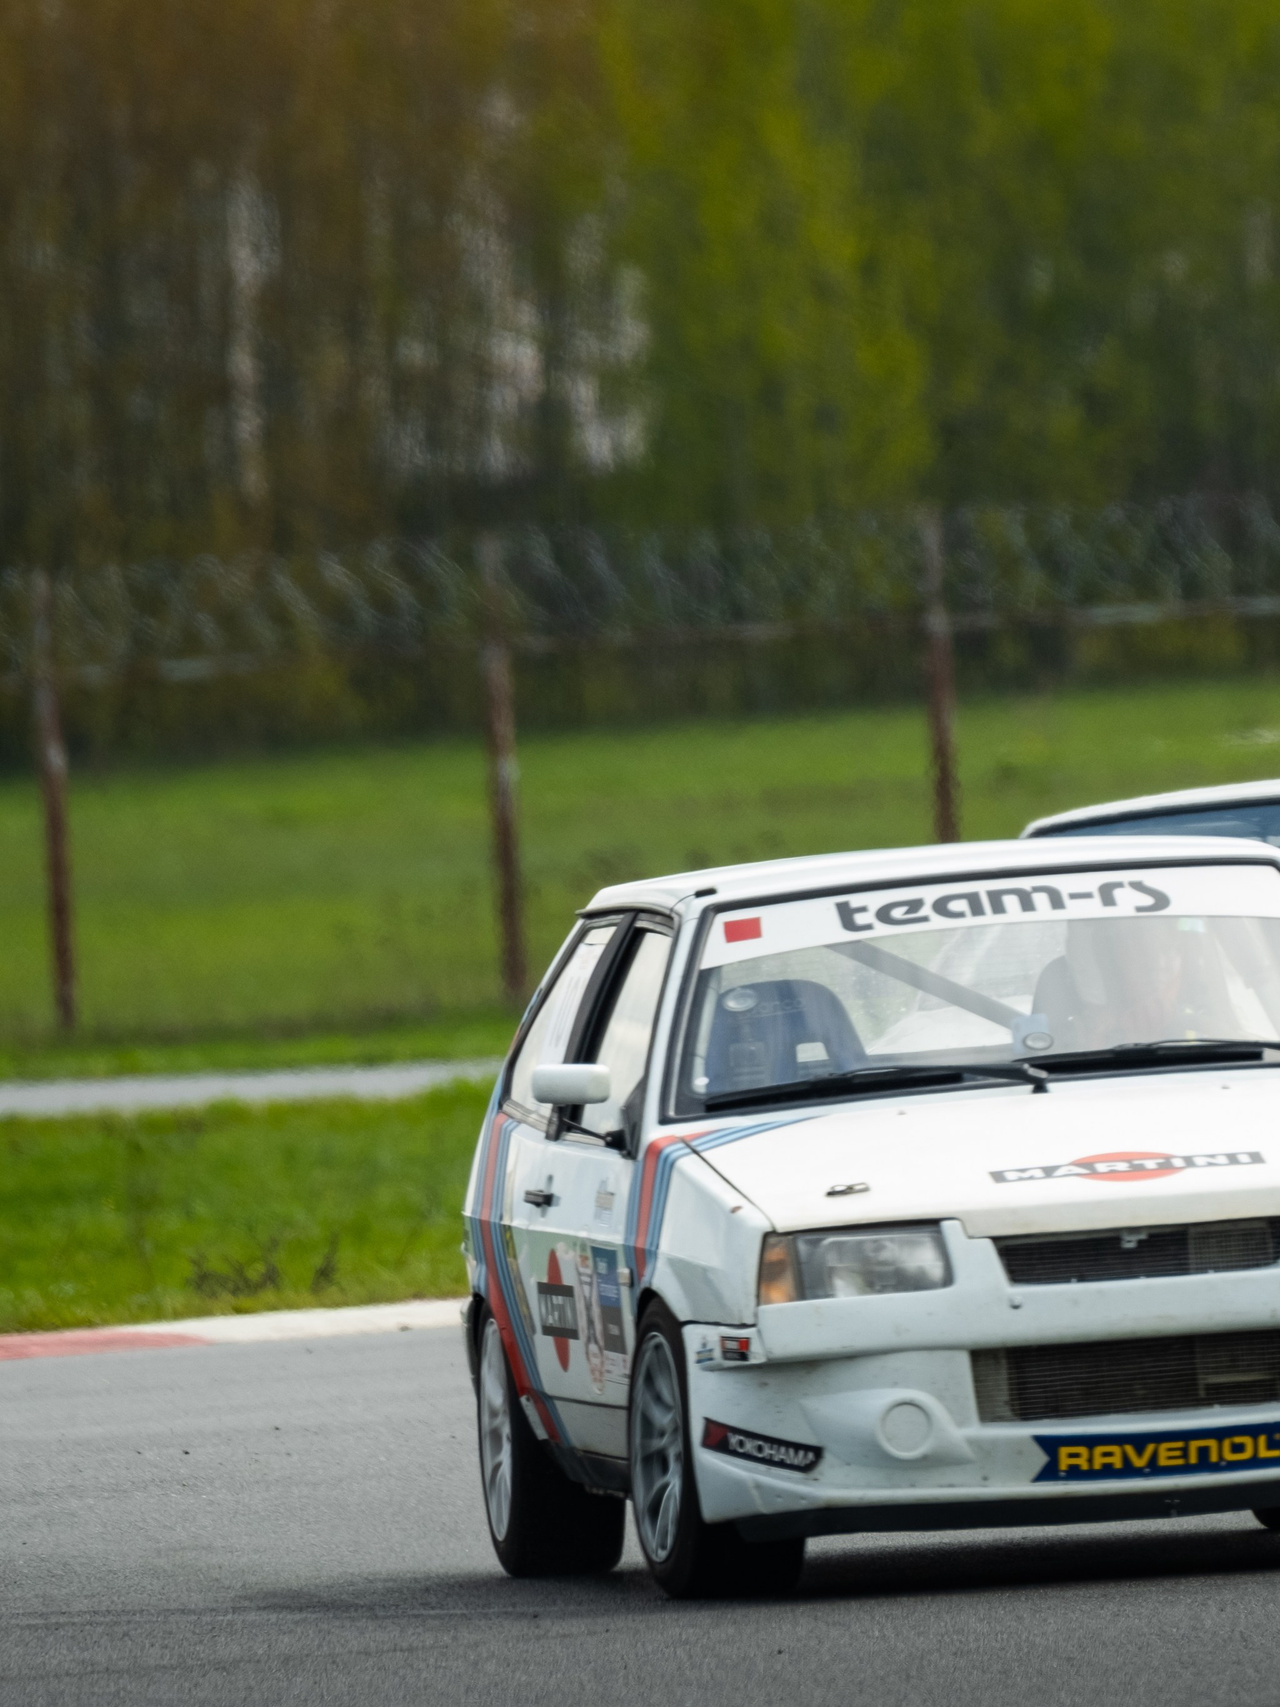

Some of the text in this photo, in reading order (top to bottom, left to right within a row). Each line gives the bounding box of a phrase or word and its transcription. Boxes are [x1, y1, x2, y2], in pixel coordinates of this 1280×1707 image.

[835, 880, 1171, 932] team-rs
[1002, 1153, 1254, 1182] MARTINI
[726, 1432, 816, 1467] YOKOHAMA
